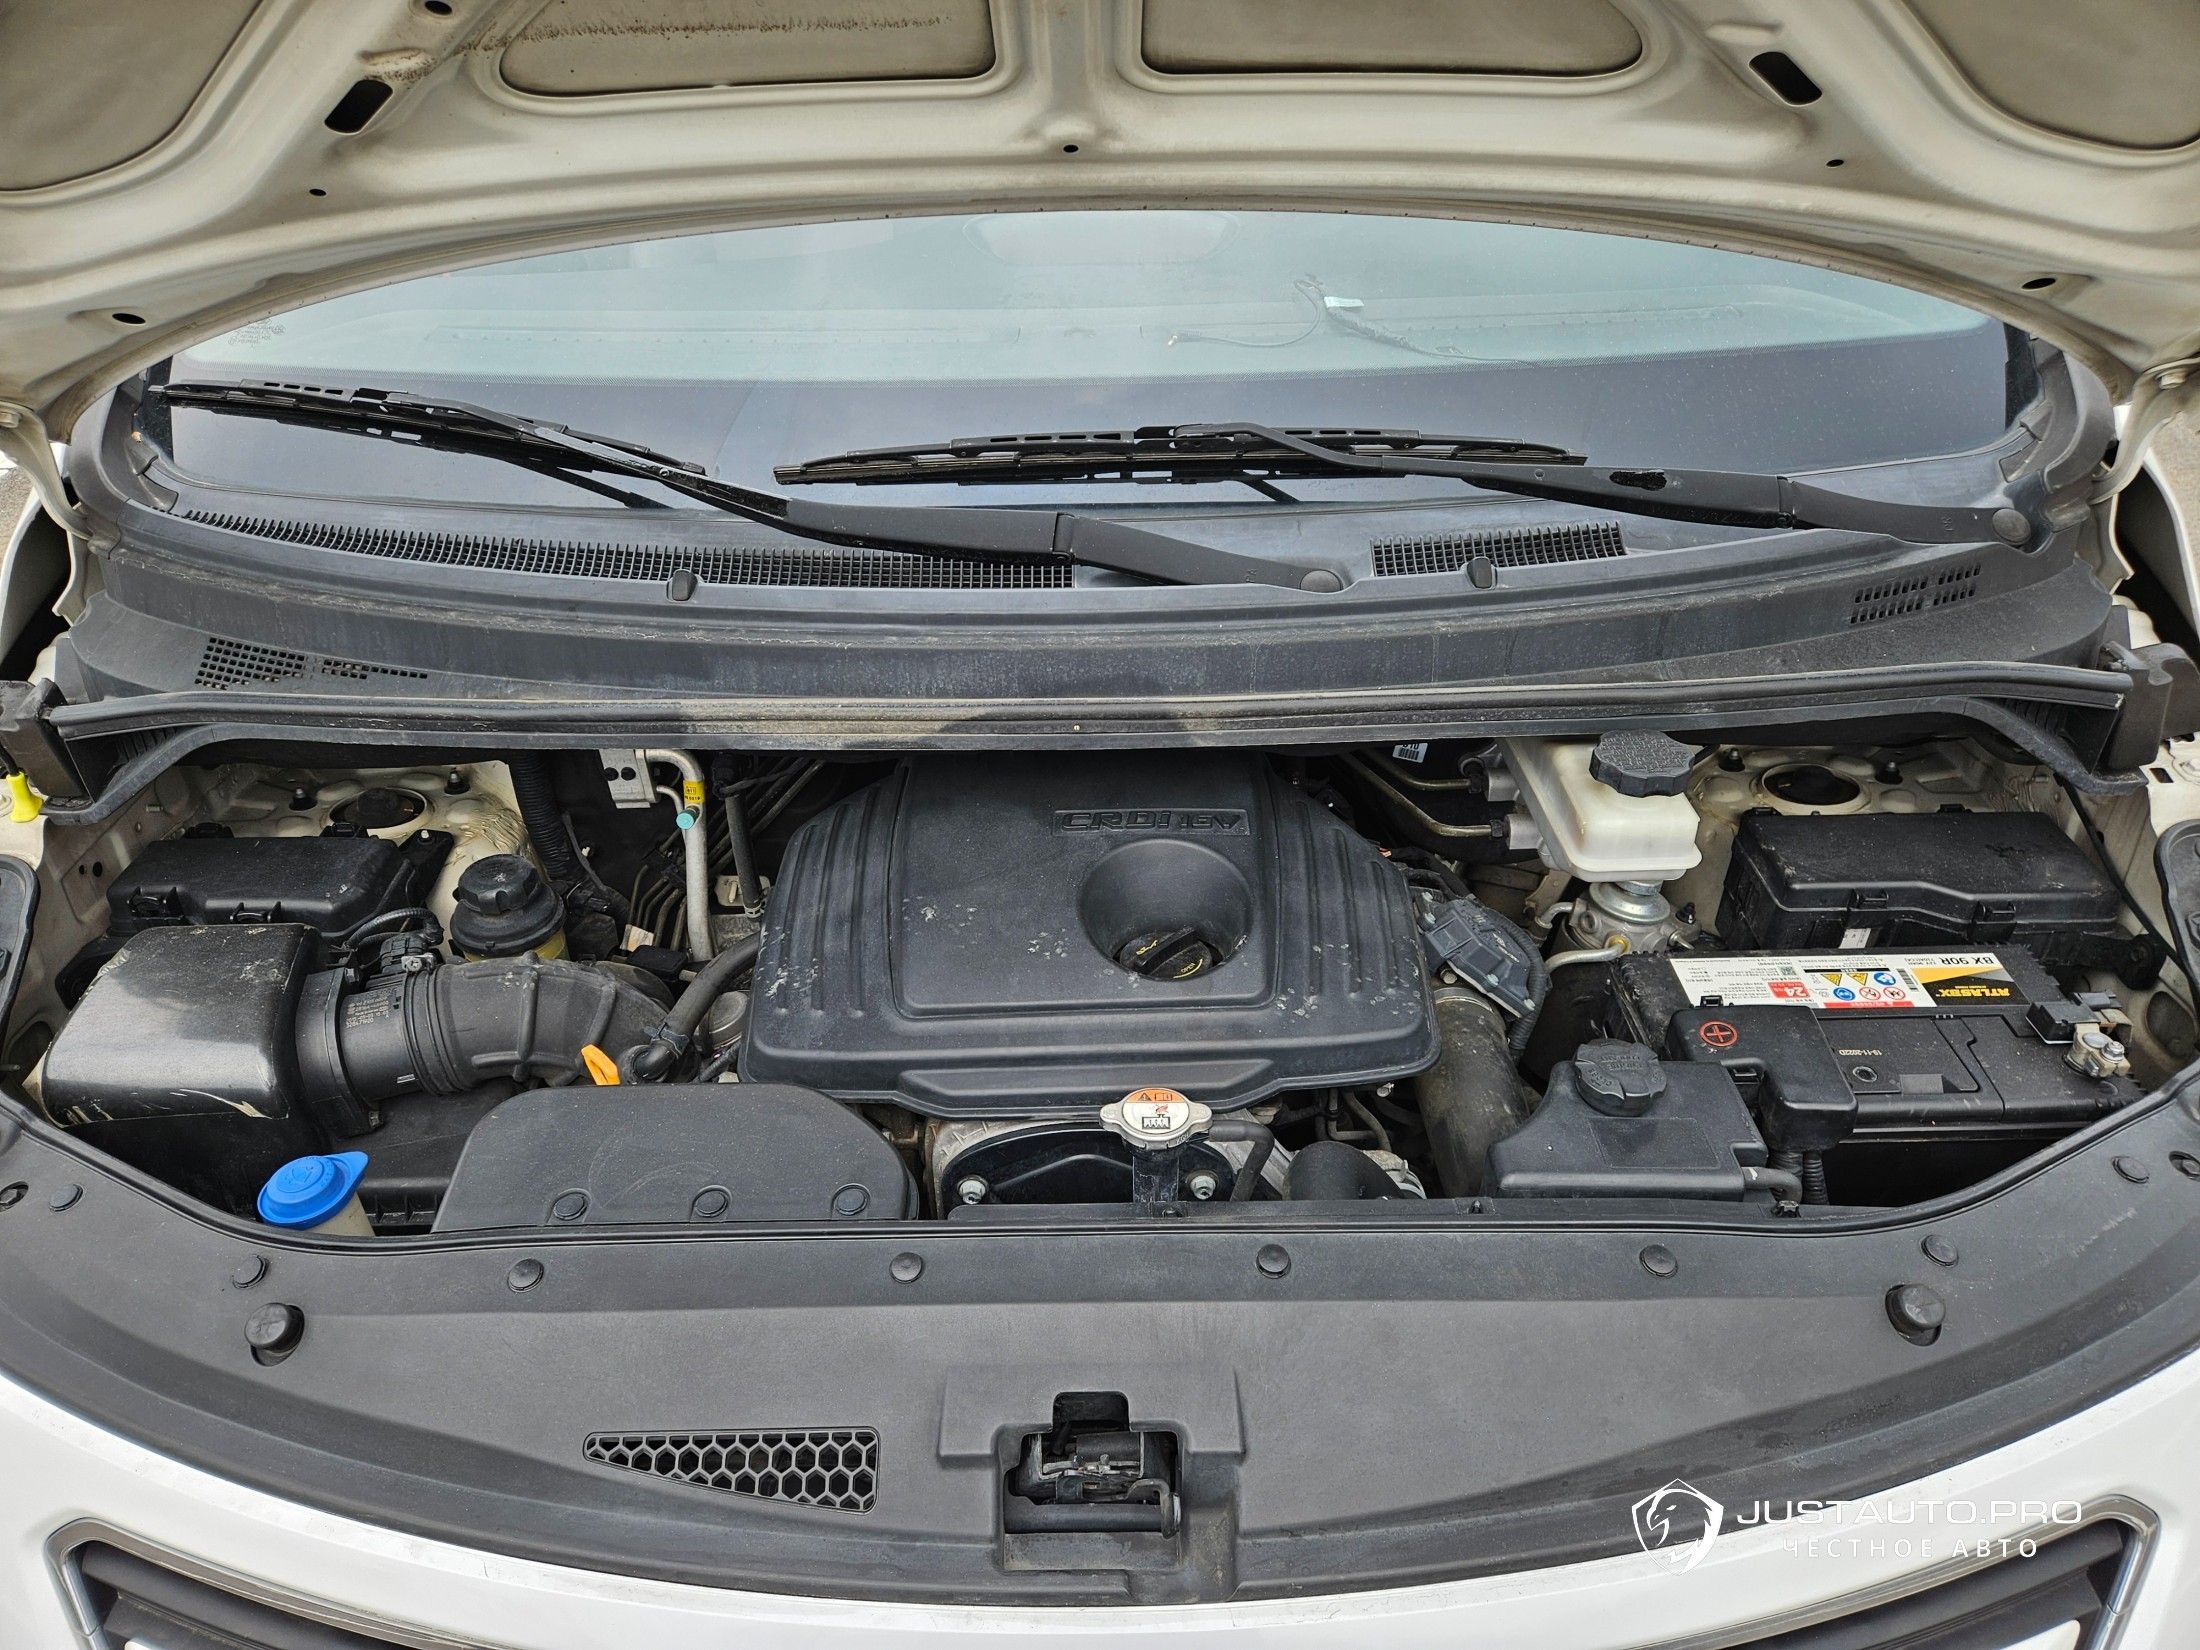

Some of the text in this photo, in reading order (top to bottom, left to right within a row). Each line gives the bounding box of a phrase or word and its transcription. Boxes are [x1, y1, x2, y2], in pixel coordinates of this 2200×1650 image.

[1941, 956, 1994, 965] BX 90R
[1784, 986, 1807, 997] 24
[1938, 988, 2010, 997] ATLASBX
